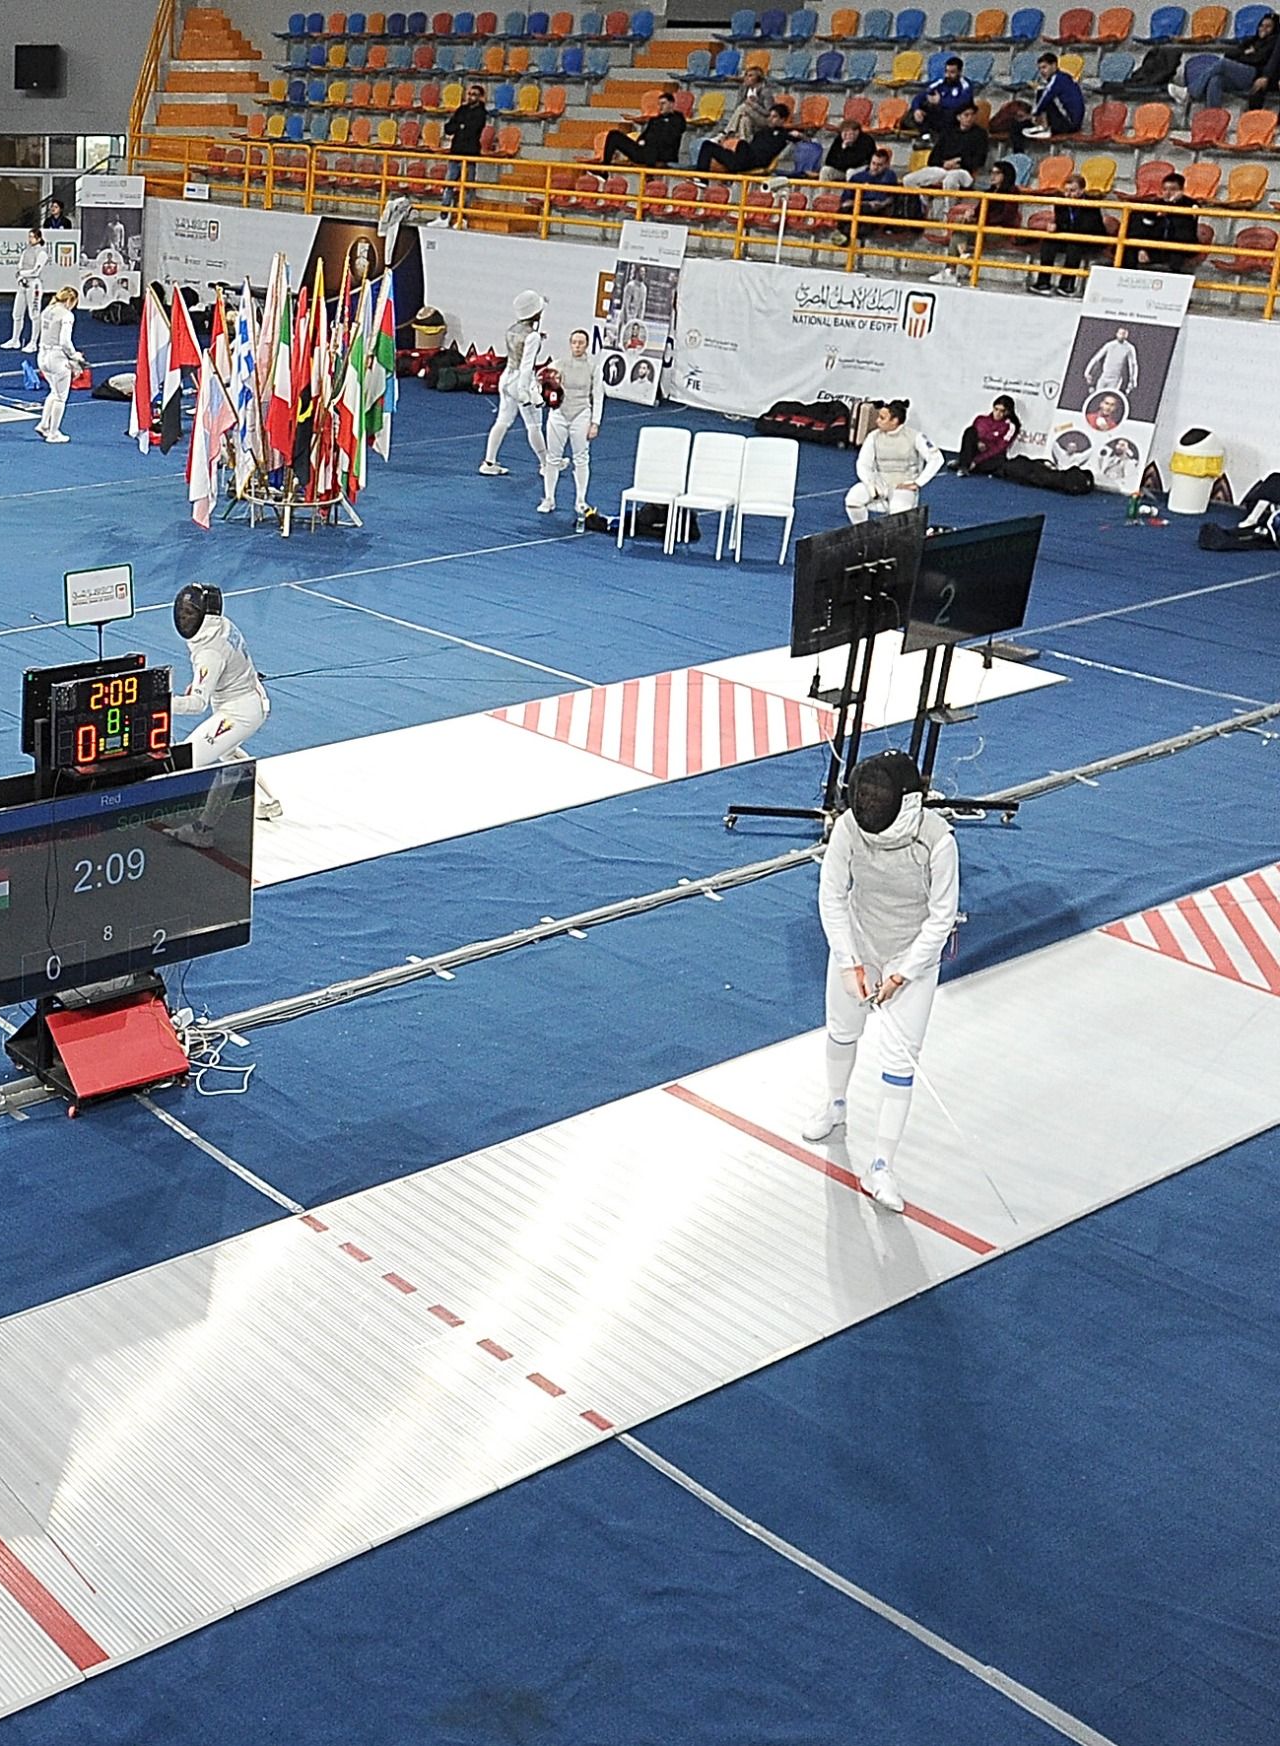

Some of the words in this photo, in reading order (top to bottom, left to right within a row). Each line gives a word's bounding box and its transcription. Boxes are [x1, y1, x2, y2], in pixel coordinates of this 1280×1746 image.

[792, 315, 831, 328] NATIONAL
[833, 317, 857, 330] BANK
[858, 320, 867, 330] OF
[870, 321, 899, 333] EGYPT
[686, 377, 702, 391] FIE
[934, 584, 956, 625] 2
[90, 677, 138, 710] 2:09
[107, 707, 120, 734] 8
[78, 725, 96, 762] 0
[150, 712, 168, 749] 2
[100, 793, 121, 807] Red
[74, 848, 145, 893] 2:09
[103, 925, 113, 941] 8
[46, 955, 61, 980] 0
[152, 929, 166, 955] 2
